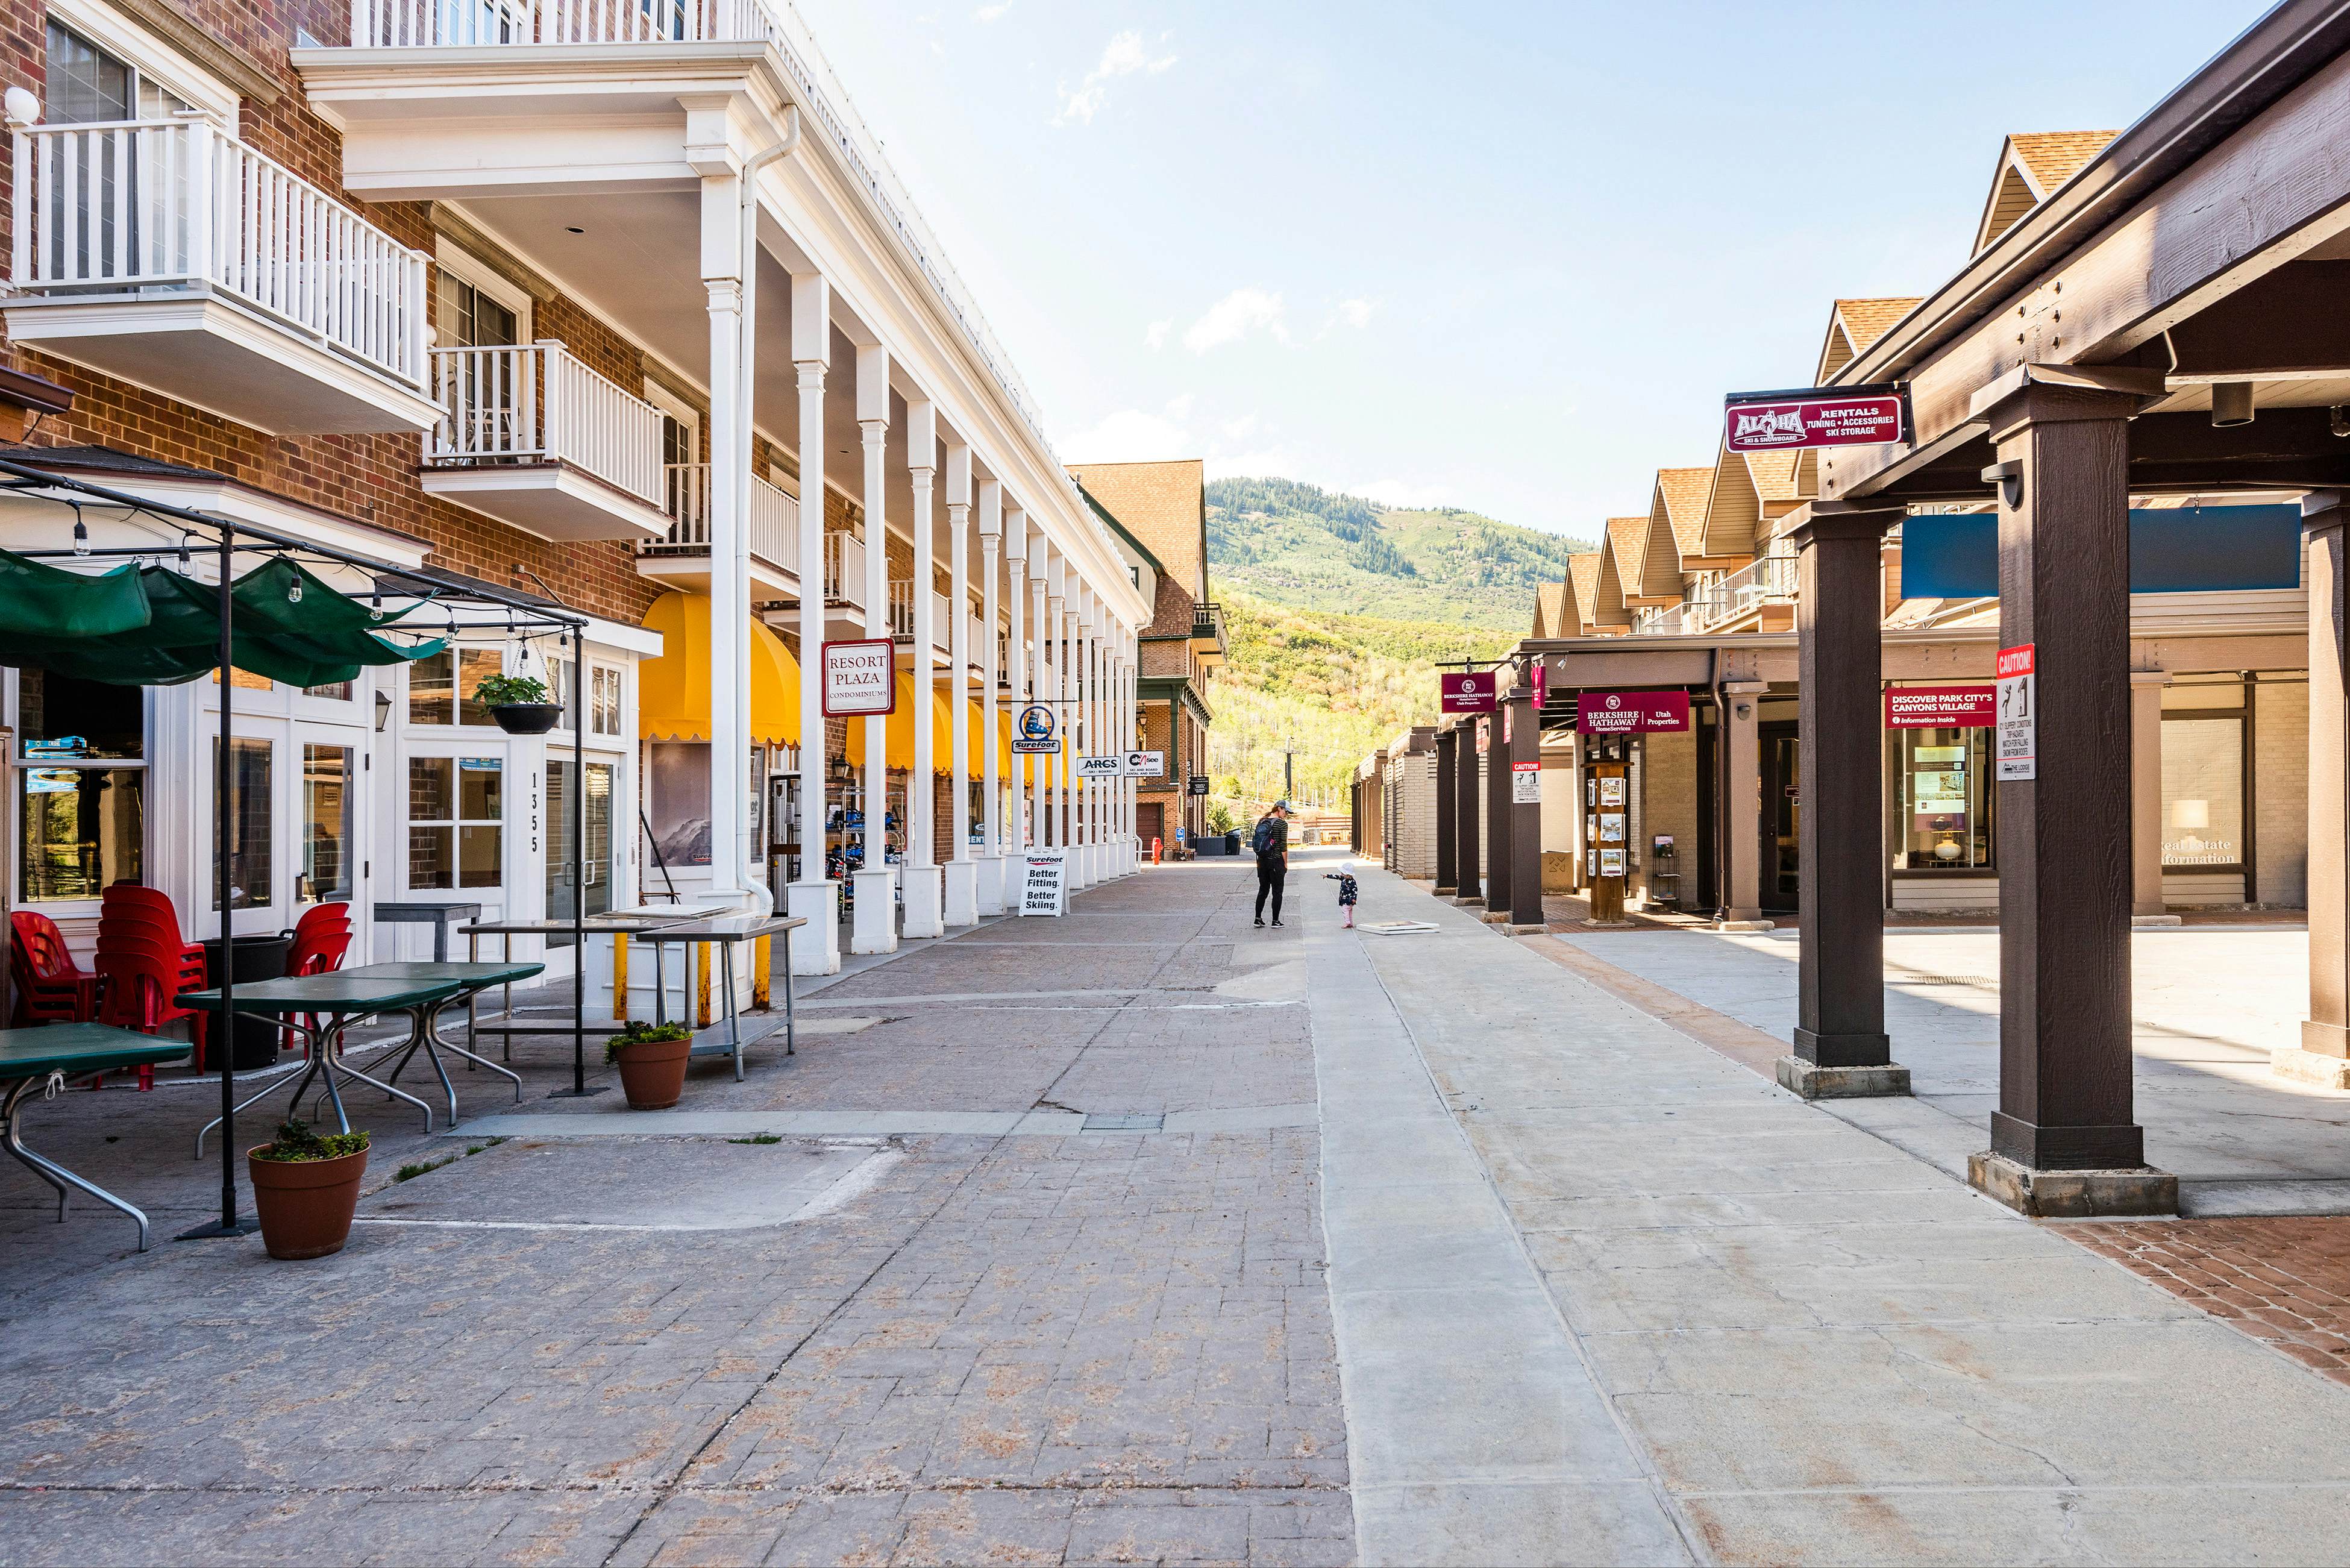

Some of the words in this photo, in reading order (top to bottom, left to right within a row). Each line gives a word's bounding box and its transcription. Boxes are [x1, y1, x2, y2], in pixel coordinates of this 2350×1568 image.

[1821, 408, 1879, 418] RENTALS
[1843, 416, 1894, 426] ACCESSORIES
[1841, 427, 1876, 436] STORAGE
[830, 656, 886, 669] RESORT
[1999, 650, 2031, 674] CAUTION!
[836, 673, 880, 685] PLAZA
[830, 690, 887, 698] CONDOMINIUMS
[1892, 695, 1937, 704] DISCOVER
[1964, 694, 1993, 702] CITY'S
[1085, 759, 1117, 768] ARCS
[2161, 839, 2184, 850] eal
[2162, 853, 2234, 864] formation
[1027, 879, 1059, 888] Fitting.
[1026, 901, 1058, 910] Skiing.
